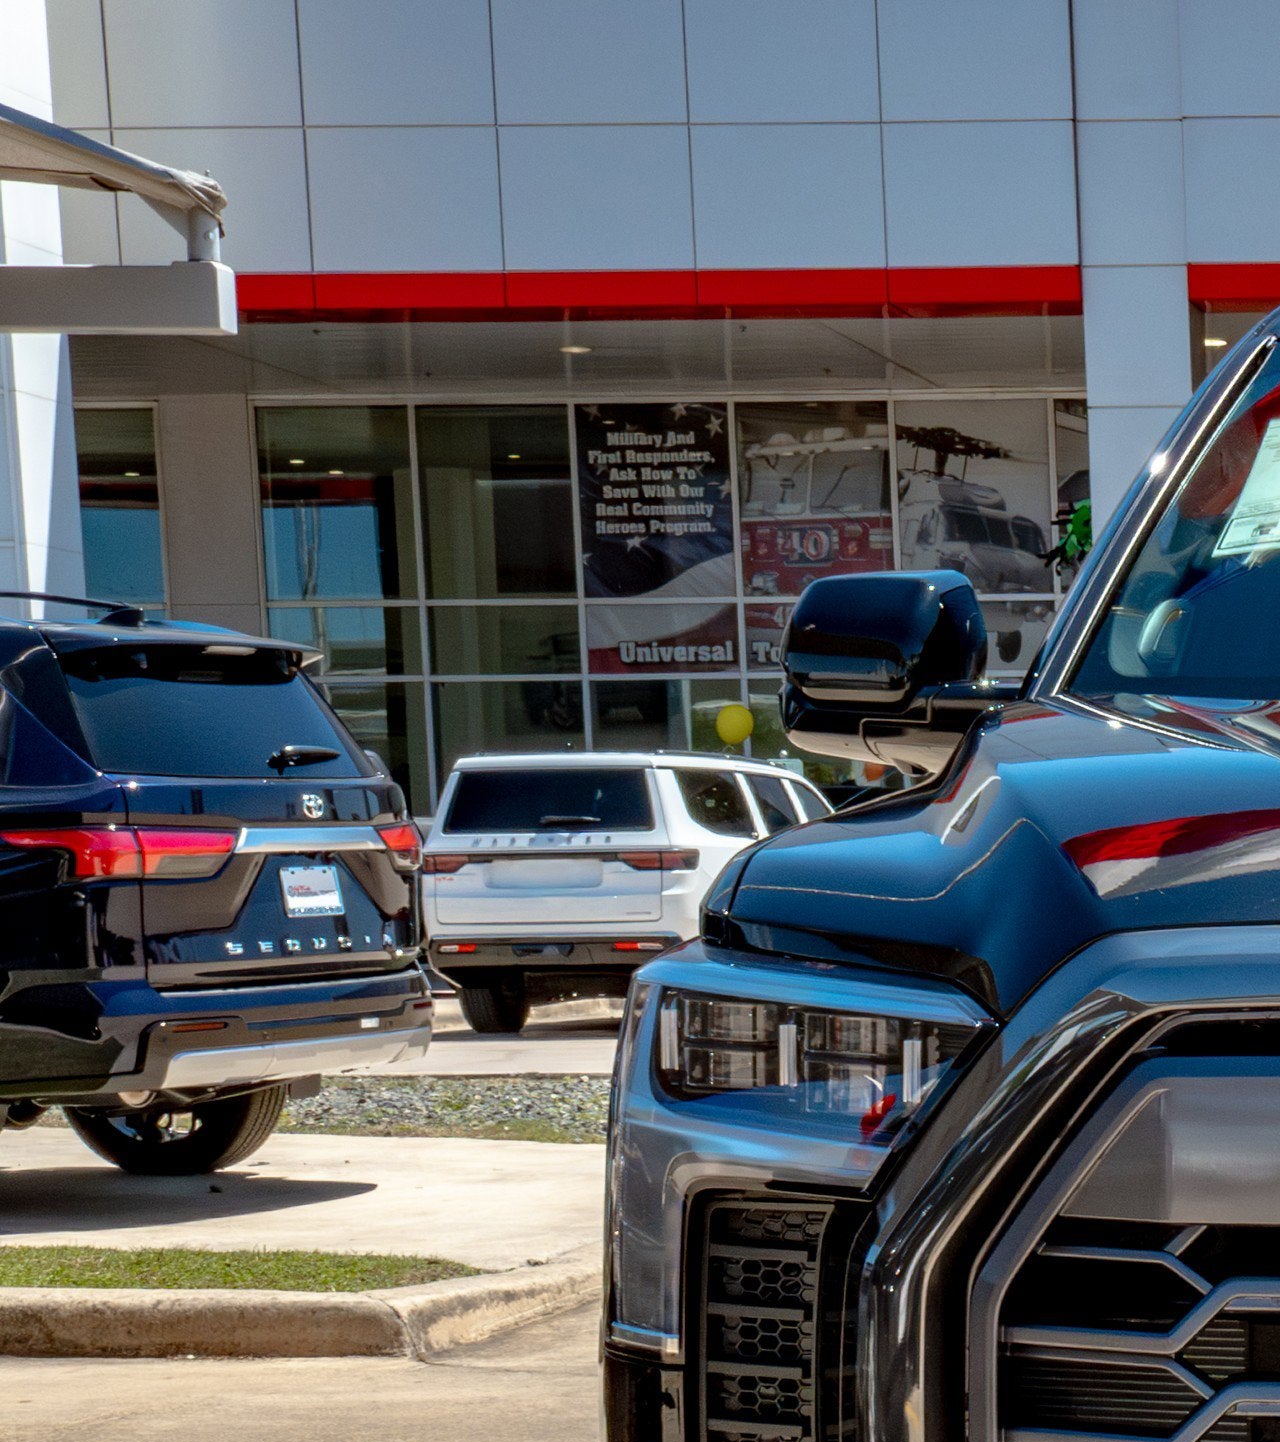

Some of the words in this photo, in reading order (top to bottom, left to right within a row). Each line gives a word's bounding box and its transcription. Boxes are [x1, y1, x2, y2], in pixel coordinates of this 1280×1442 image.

[606, 431, 662, 448] Military
[664, 431, 696, 447] And
[588, 450, 622, 464] First
[609, 467, 637, 481] Ask
[640, 467, 673, 481] How
[676, 466, 697, 480] To
[602, 485, 639, 499] Save
[642, 484, 676, 498] With
[679, 484, 705, 498] Our
[596, 503, 629, 516] Real
[632, 502, 714, 518] Community
[596, 520, 646, 534] Heroes
[649, 519, 716, 536] Program.
[618, 640, 734, 663] Universal
